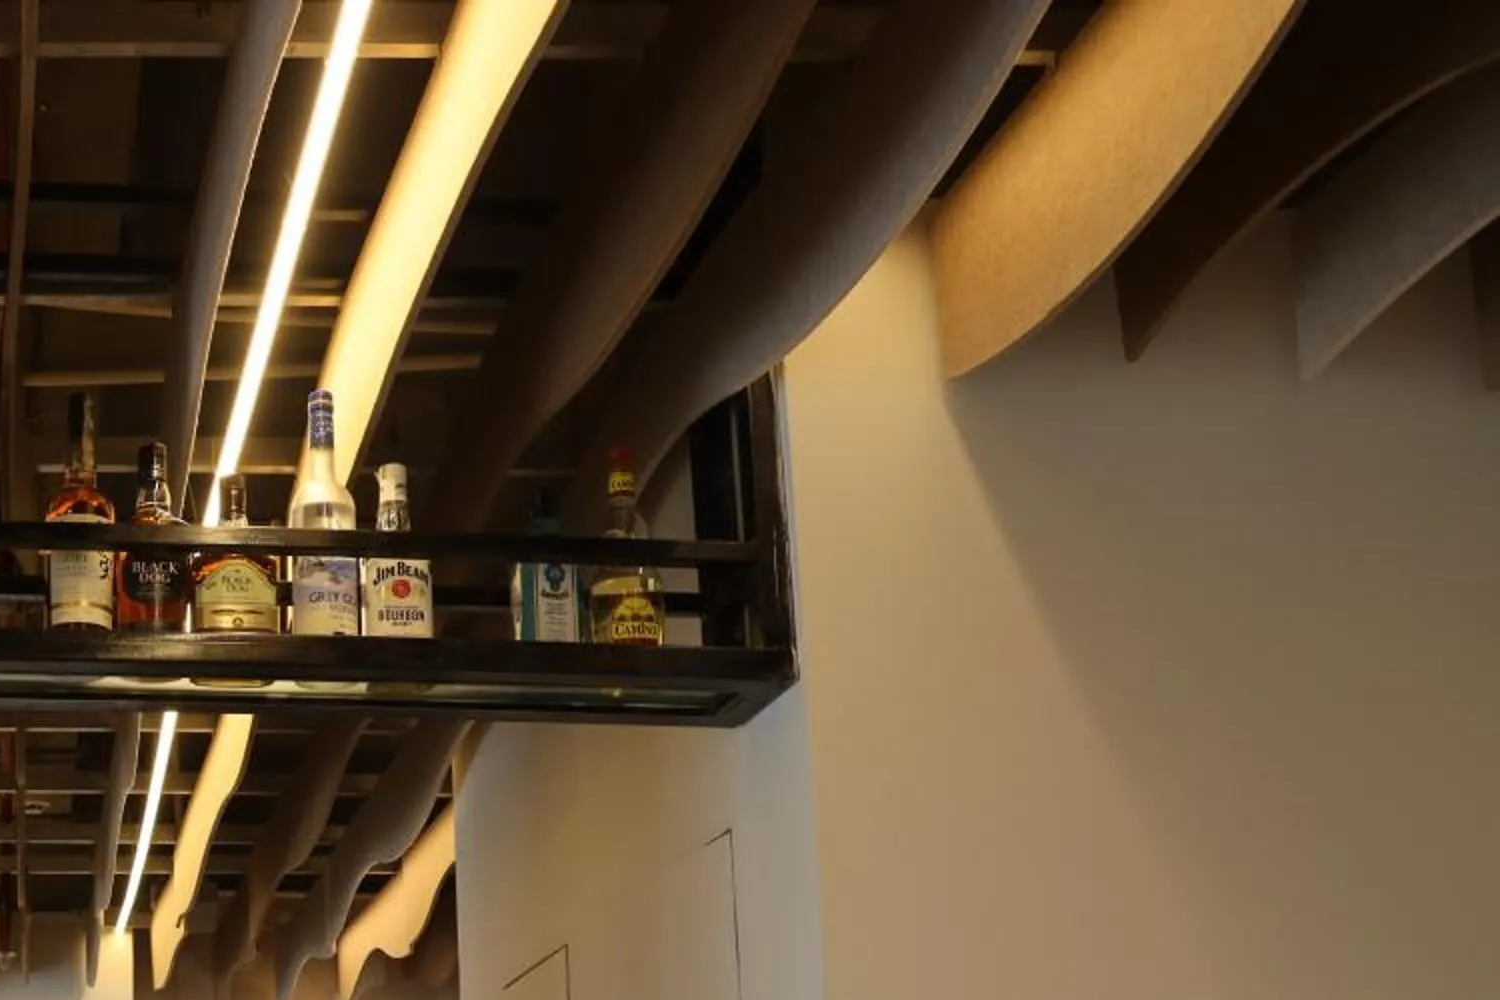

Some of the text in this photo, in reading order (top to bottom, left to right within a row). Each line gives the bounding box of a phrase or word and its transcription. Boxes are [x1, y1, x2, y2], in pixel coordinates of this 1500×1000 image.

[132, 560, 180, 574] BLACK
[138, 573, 171, 585] DOG
[372, 562, 429, 587] JIM BEAM
[377, 609, 425, 622] BOURBON
